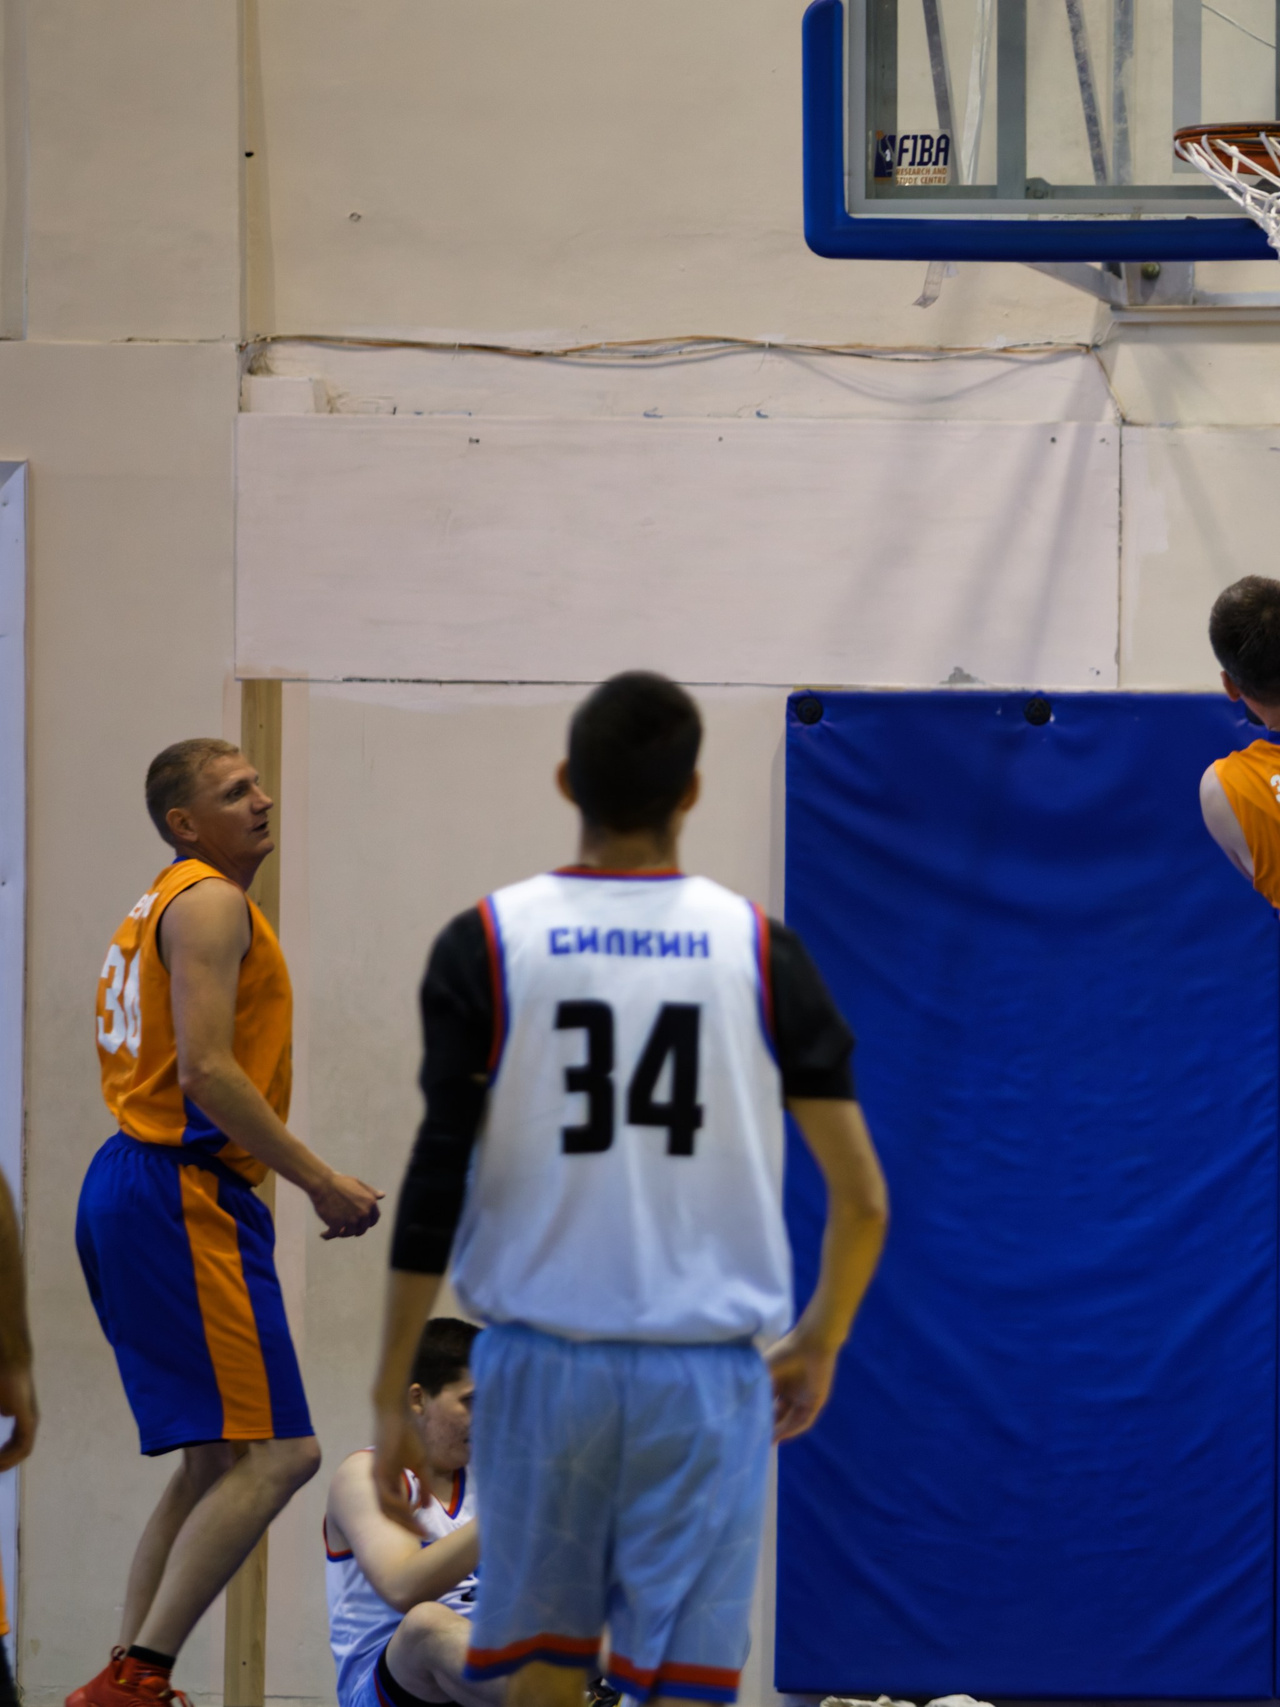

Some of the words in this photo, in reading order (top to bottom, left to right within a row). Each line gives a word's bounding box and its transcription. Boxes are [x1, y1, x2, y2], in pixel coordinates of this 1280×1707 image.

[897, 134, 950, 166] FIBA
[896, 176, 918, 184] STUDY
[920, 176, 946, 184] CENTRE
[554, 999, 704, 1157] 34
